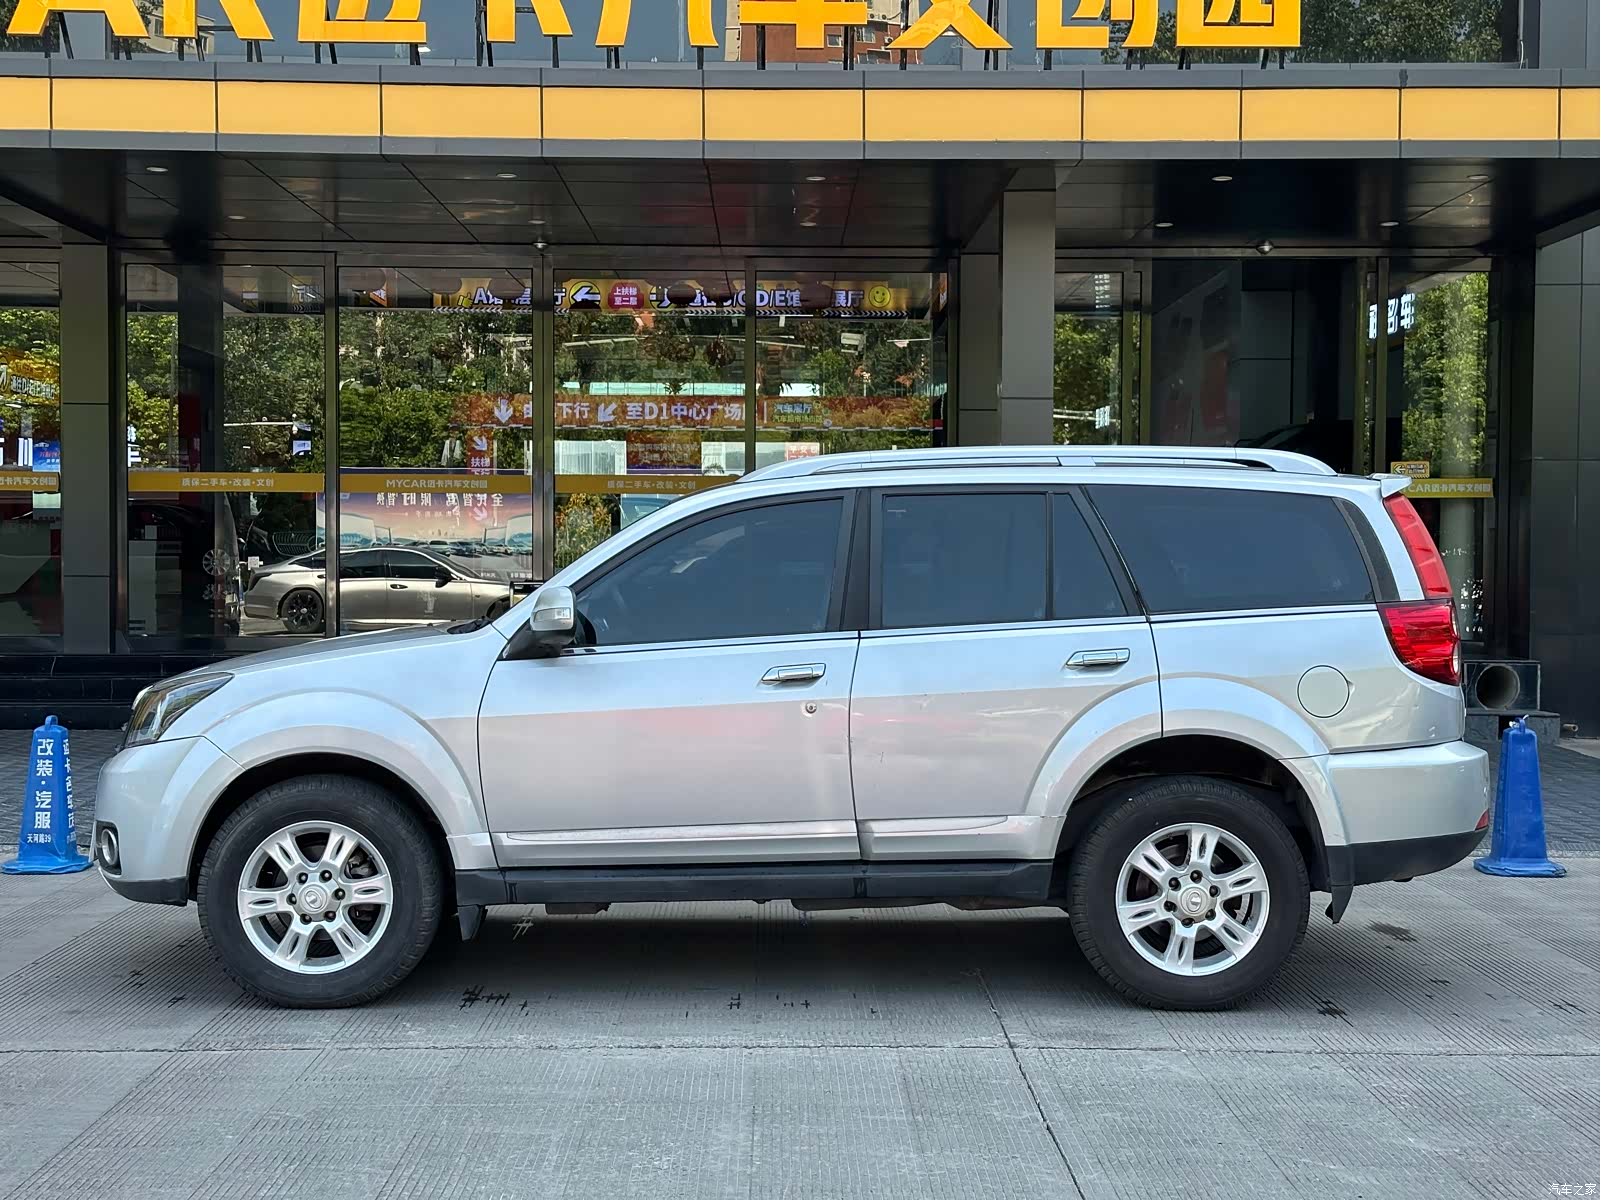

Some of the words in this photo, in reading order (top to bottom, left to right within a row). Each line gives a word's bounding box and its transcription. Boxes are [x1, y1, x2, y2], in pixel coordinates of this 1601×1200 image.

[614, 287, 638, 296] 上扶梯
[471, 457, 490, 467] 扶梯
[34, 739, 54, 829] 改装·汽服
